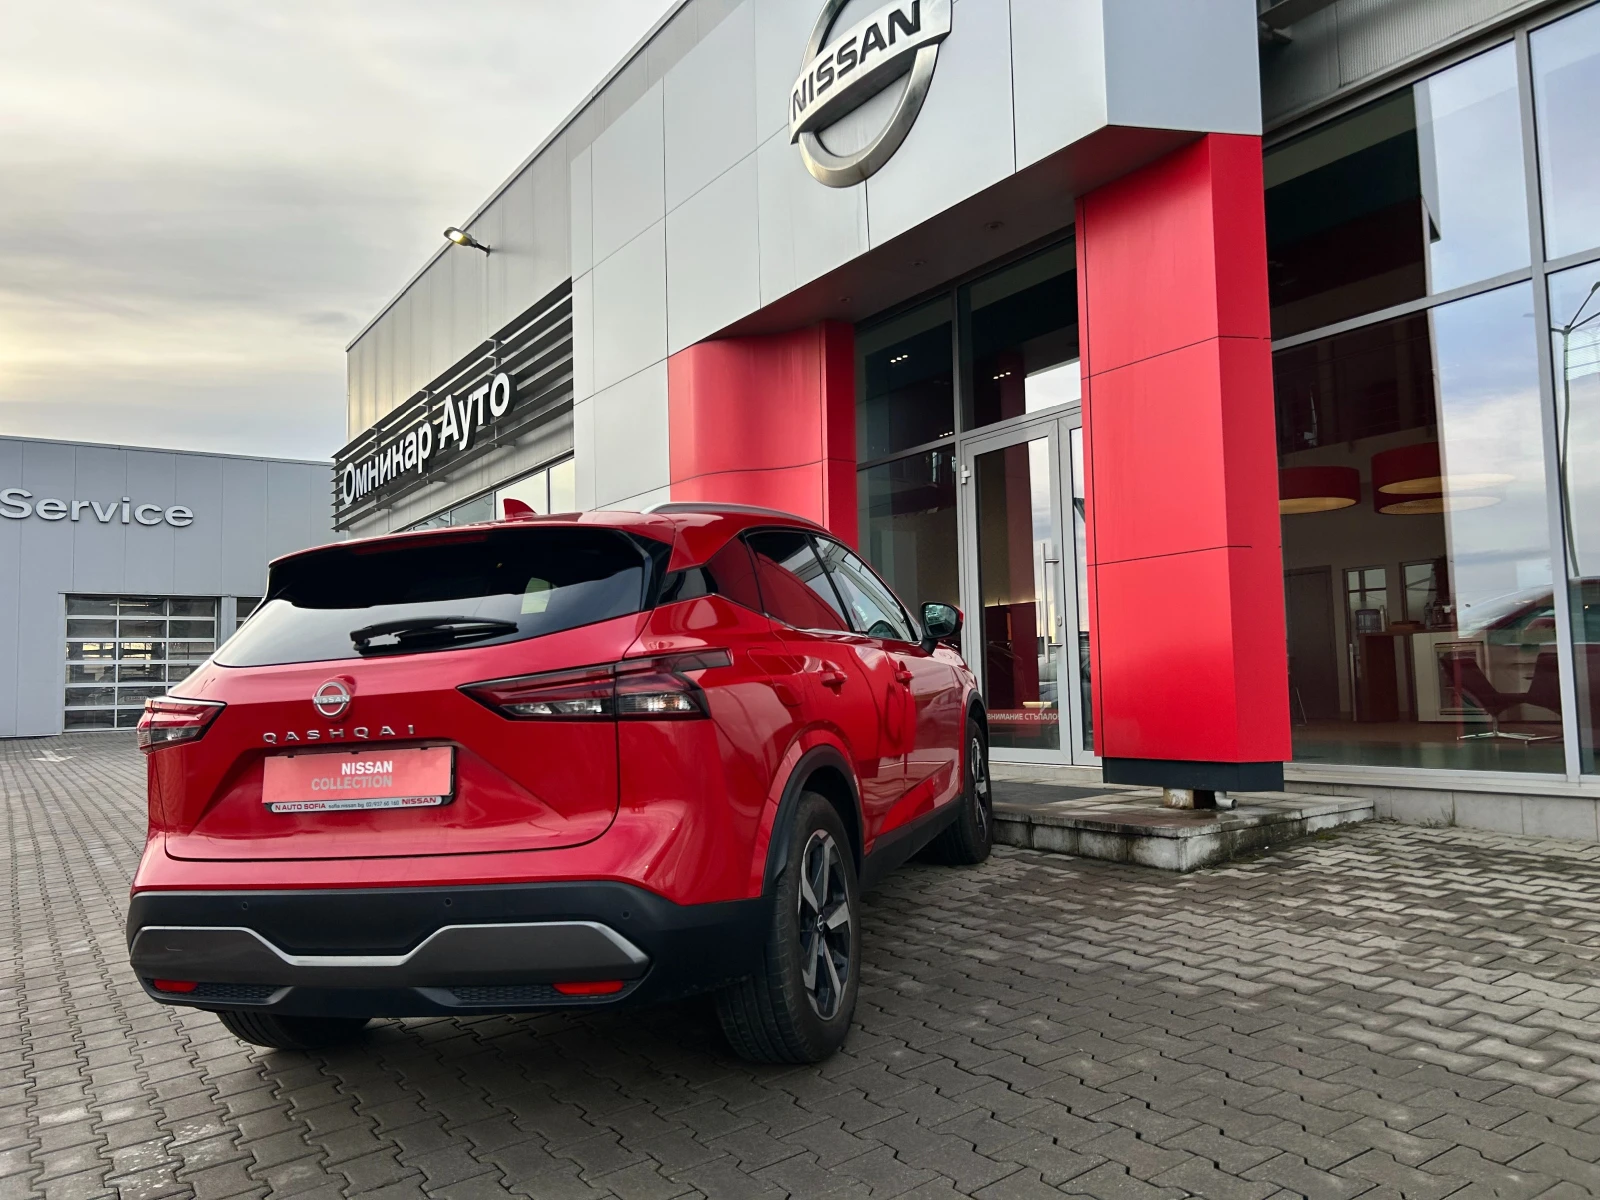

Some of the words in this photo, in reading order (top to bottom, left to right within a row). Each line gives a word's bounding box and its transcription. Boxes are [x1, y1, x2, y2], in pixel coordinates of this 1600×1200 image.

[792, 0, 921, 124] NISSAN
[343, 422, 433, 506] Омникар
[439, 372, 510, 451] Ауто
[0, 487, 194, 527] Service
[313, 695, 350, 704] NISSAN
[263, 724, 415, 745] QASHQAI
[341, 760, 393, 775] NISSAN
[311, 775, 393, 791] COLLECTION
[282, 803, 303, 811] AUTO
[401, 797, 437, 805] NISSAN
